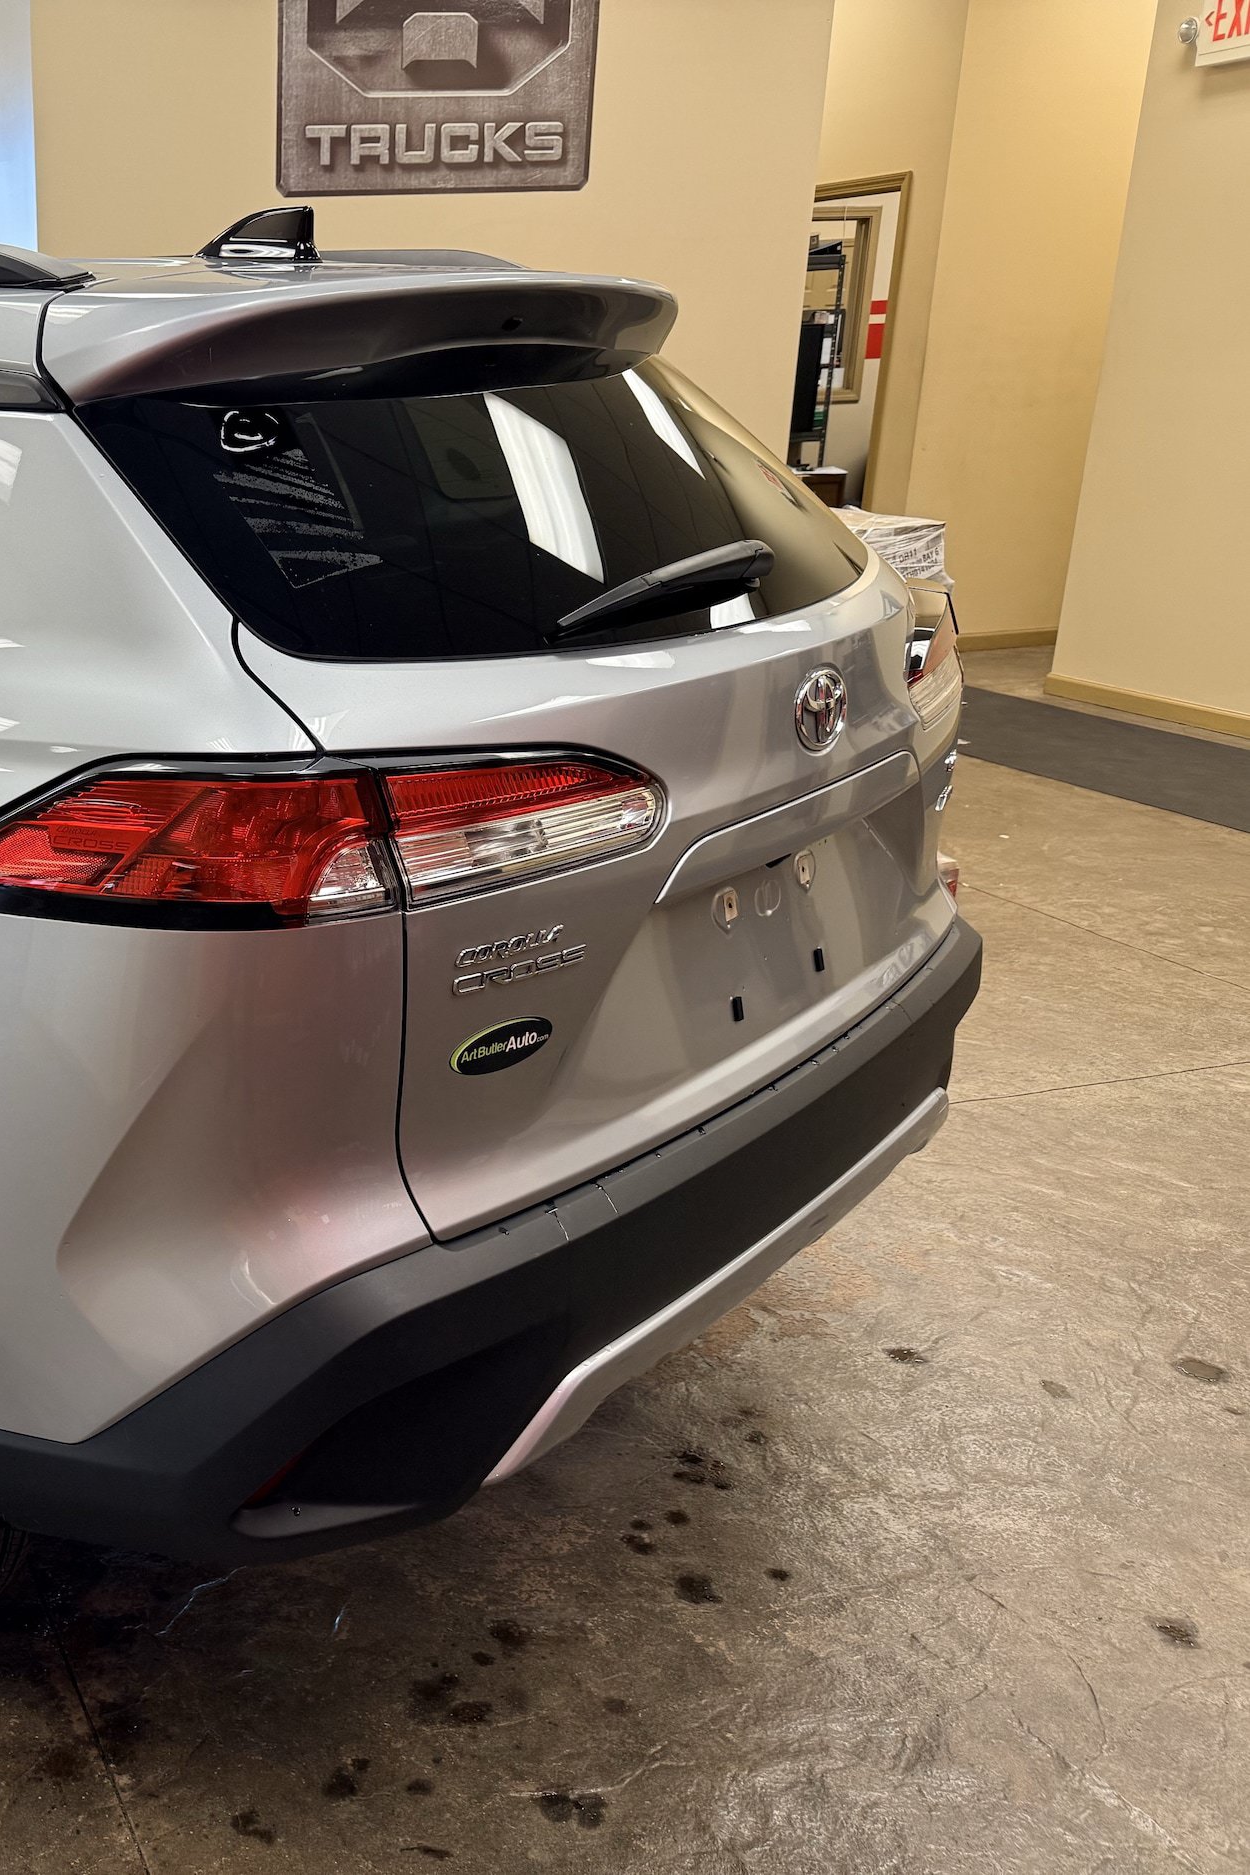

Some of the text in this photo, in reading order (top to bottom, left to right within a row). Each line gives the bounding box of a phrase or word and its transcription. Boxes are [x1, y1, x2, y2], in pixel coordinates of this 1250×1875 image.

[305, 121, 565, 166] TRUCKS
[53, 836, 131, 851] CROSS
[455, 924, 564, 968] COROLLA
[453, 944, 587, 996] CROSS
